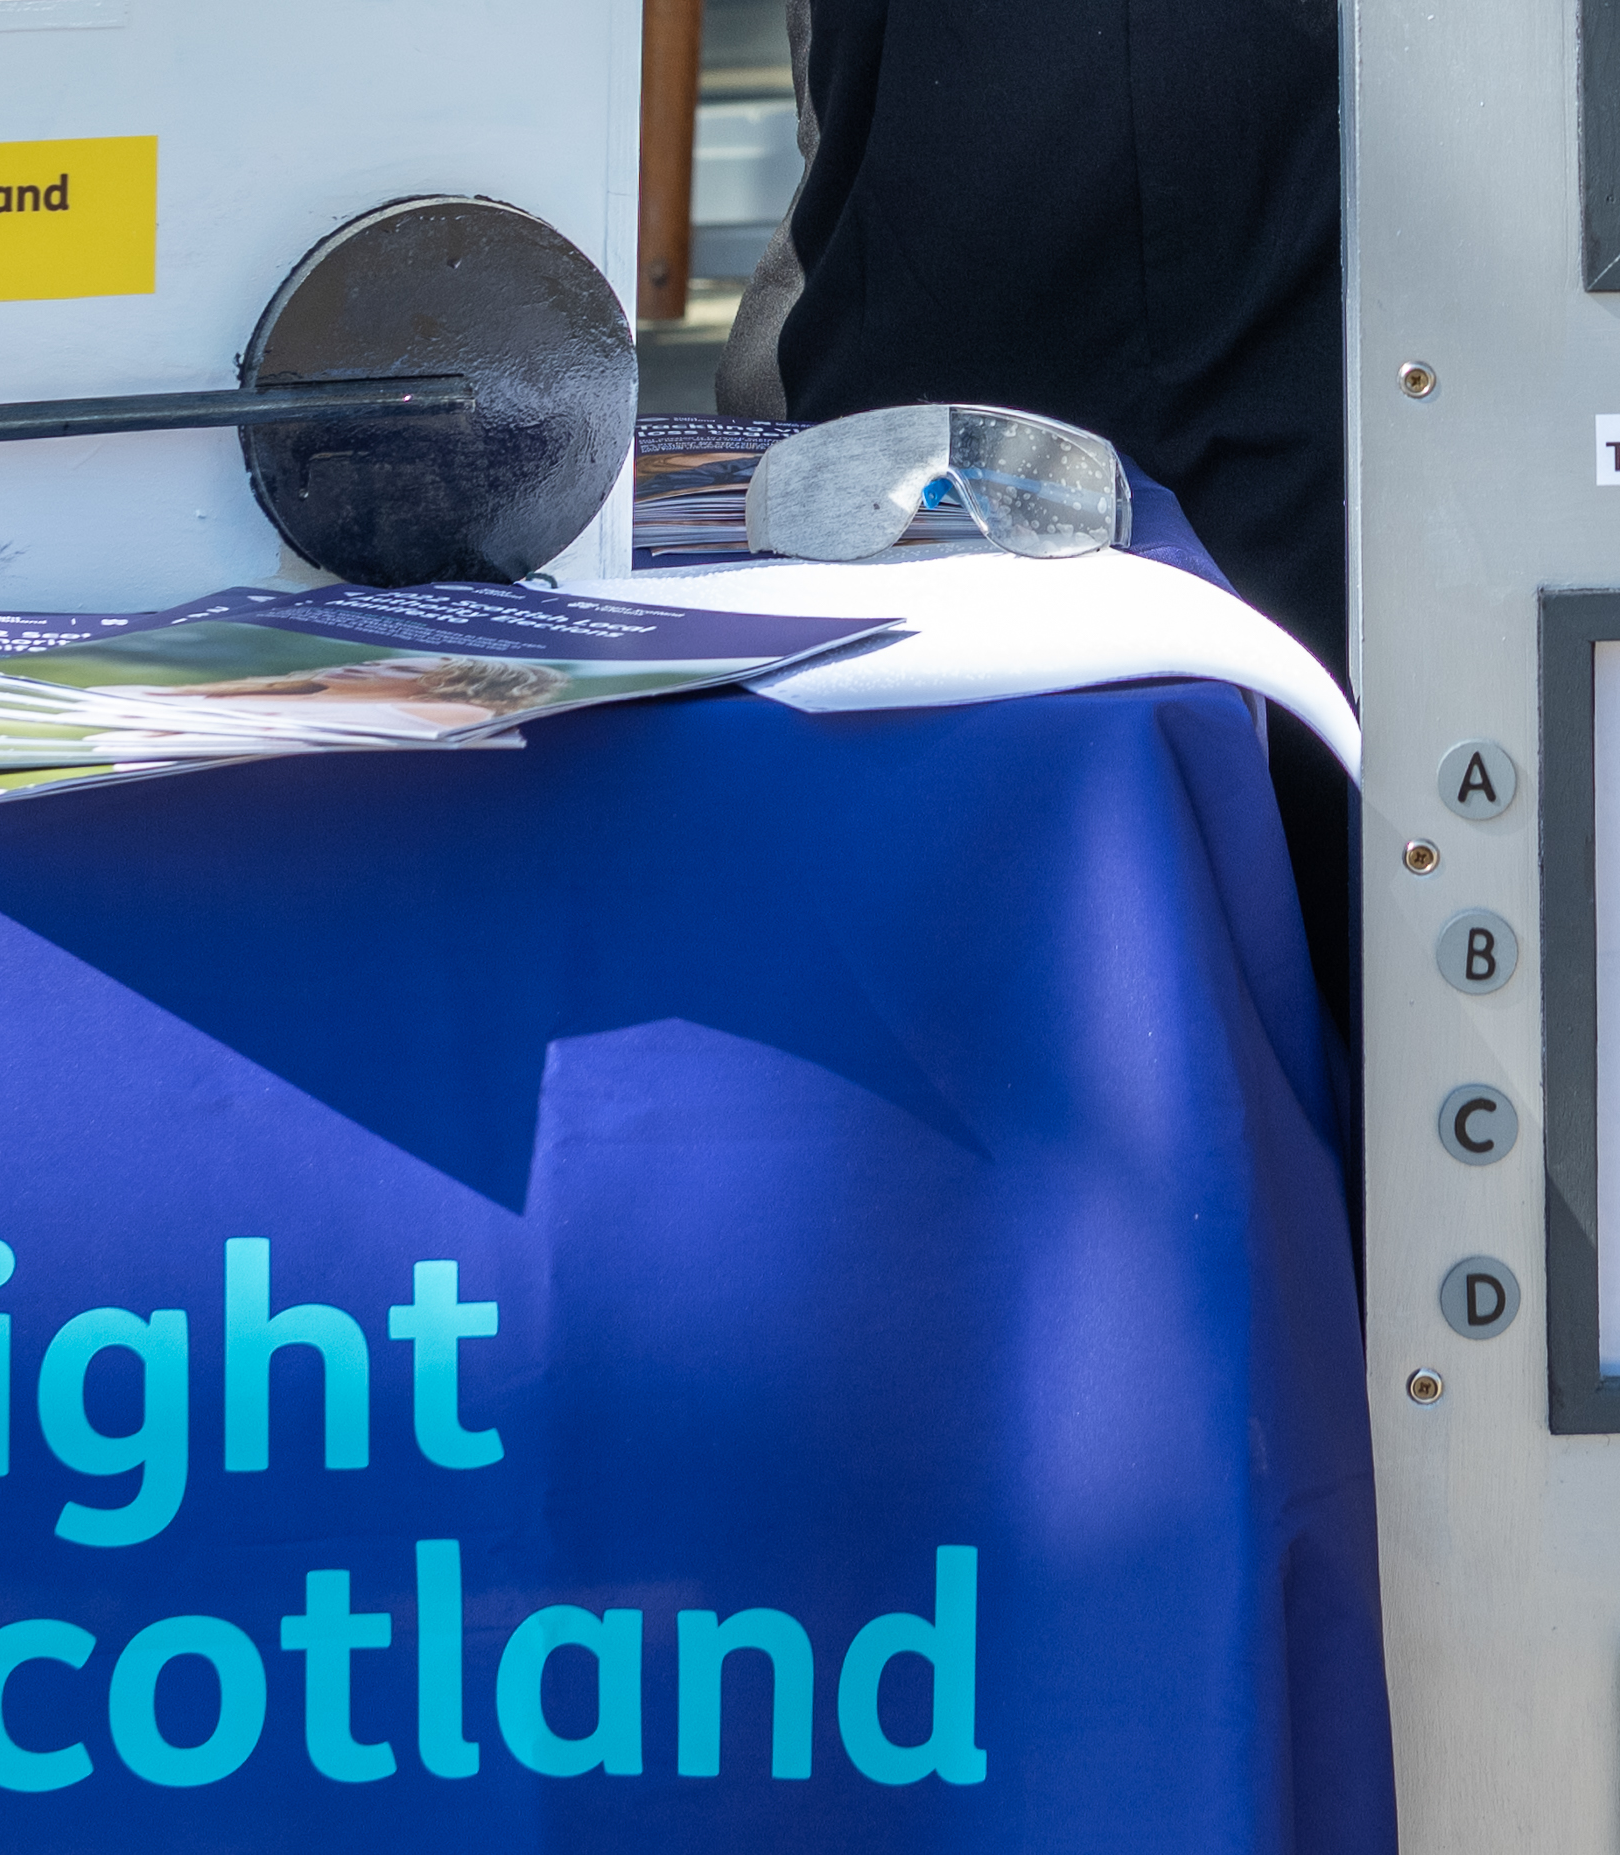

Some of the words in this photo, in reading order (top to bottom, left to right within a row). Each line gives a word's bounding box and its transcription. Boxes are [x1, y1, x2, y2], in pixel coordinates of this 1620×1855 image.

[1457, 751, 1497, 804] A
[1465, 927, 1497, 982] B
[1453, 1097, 1497, 1154] C
[1465, 1273, 1506, 1327] D
